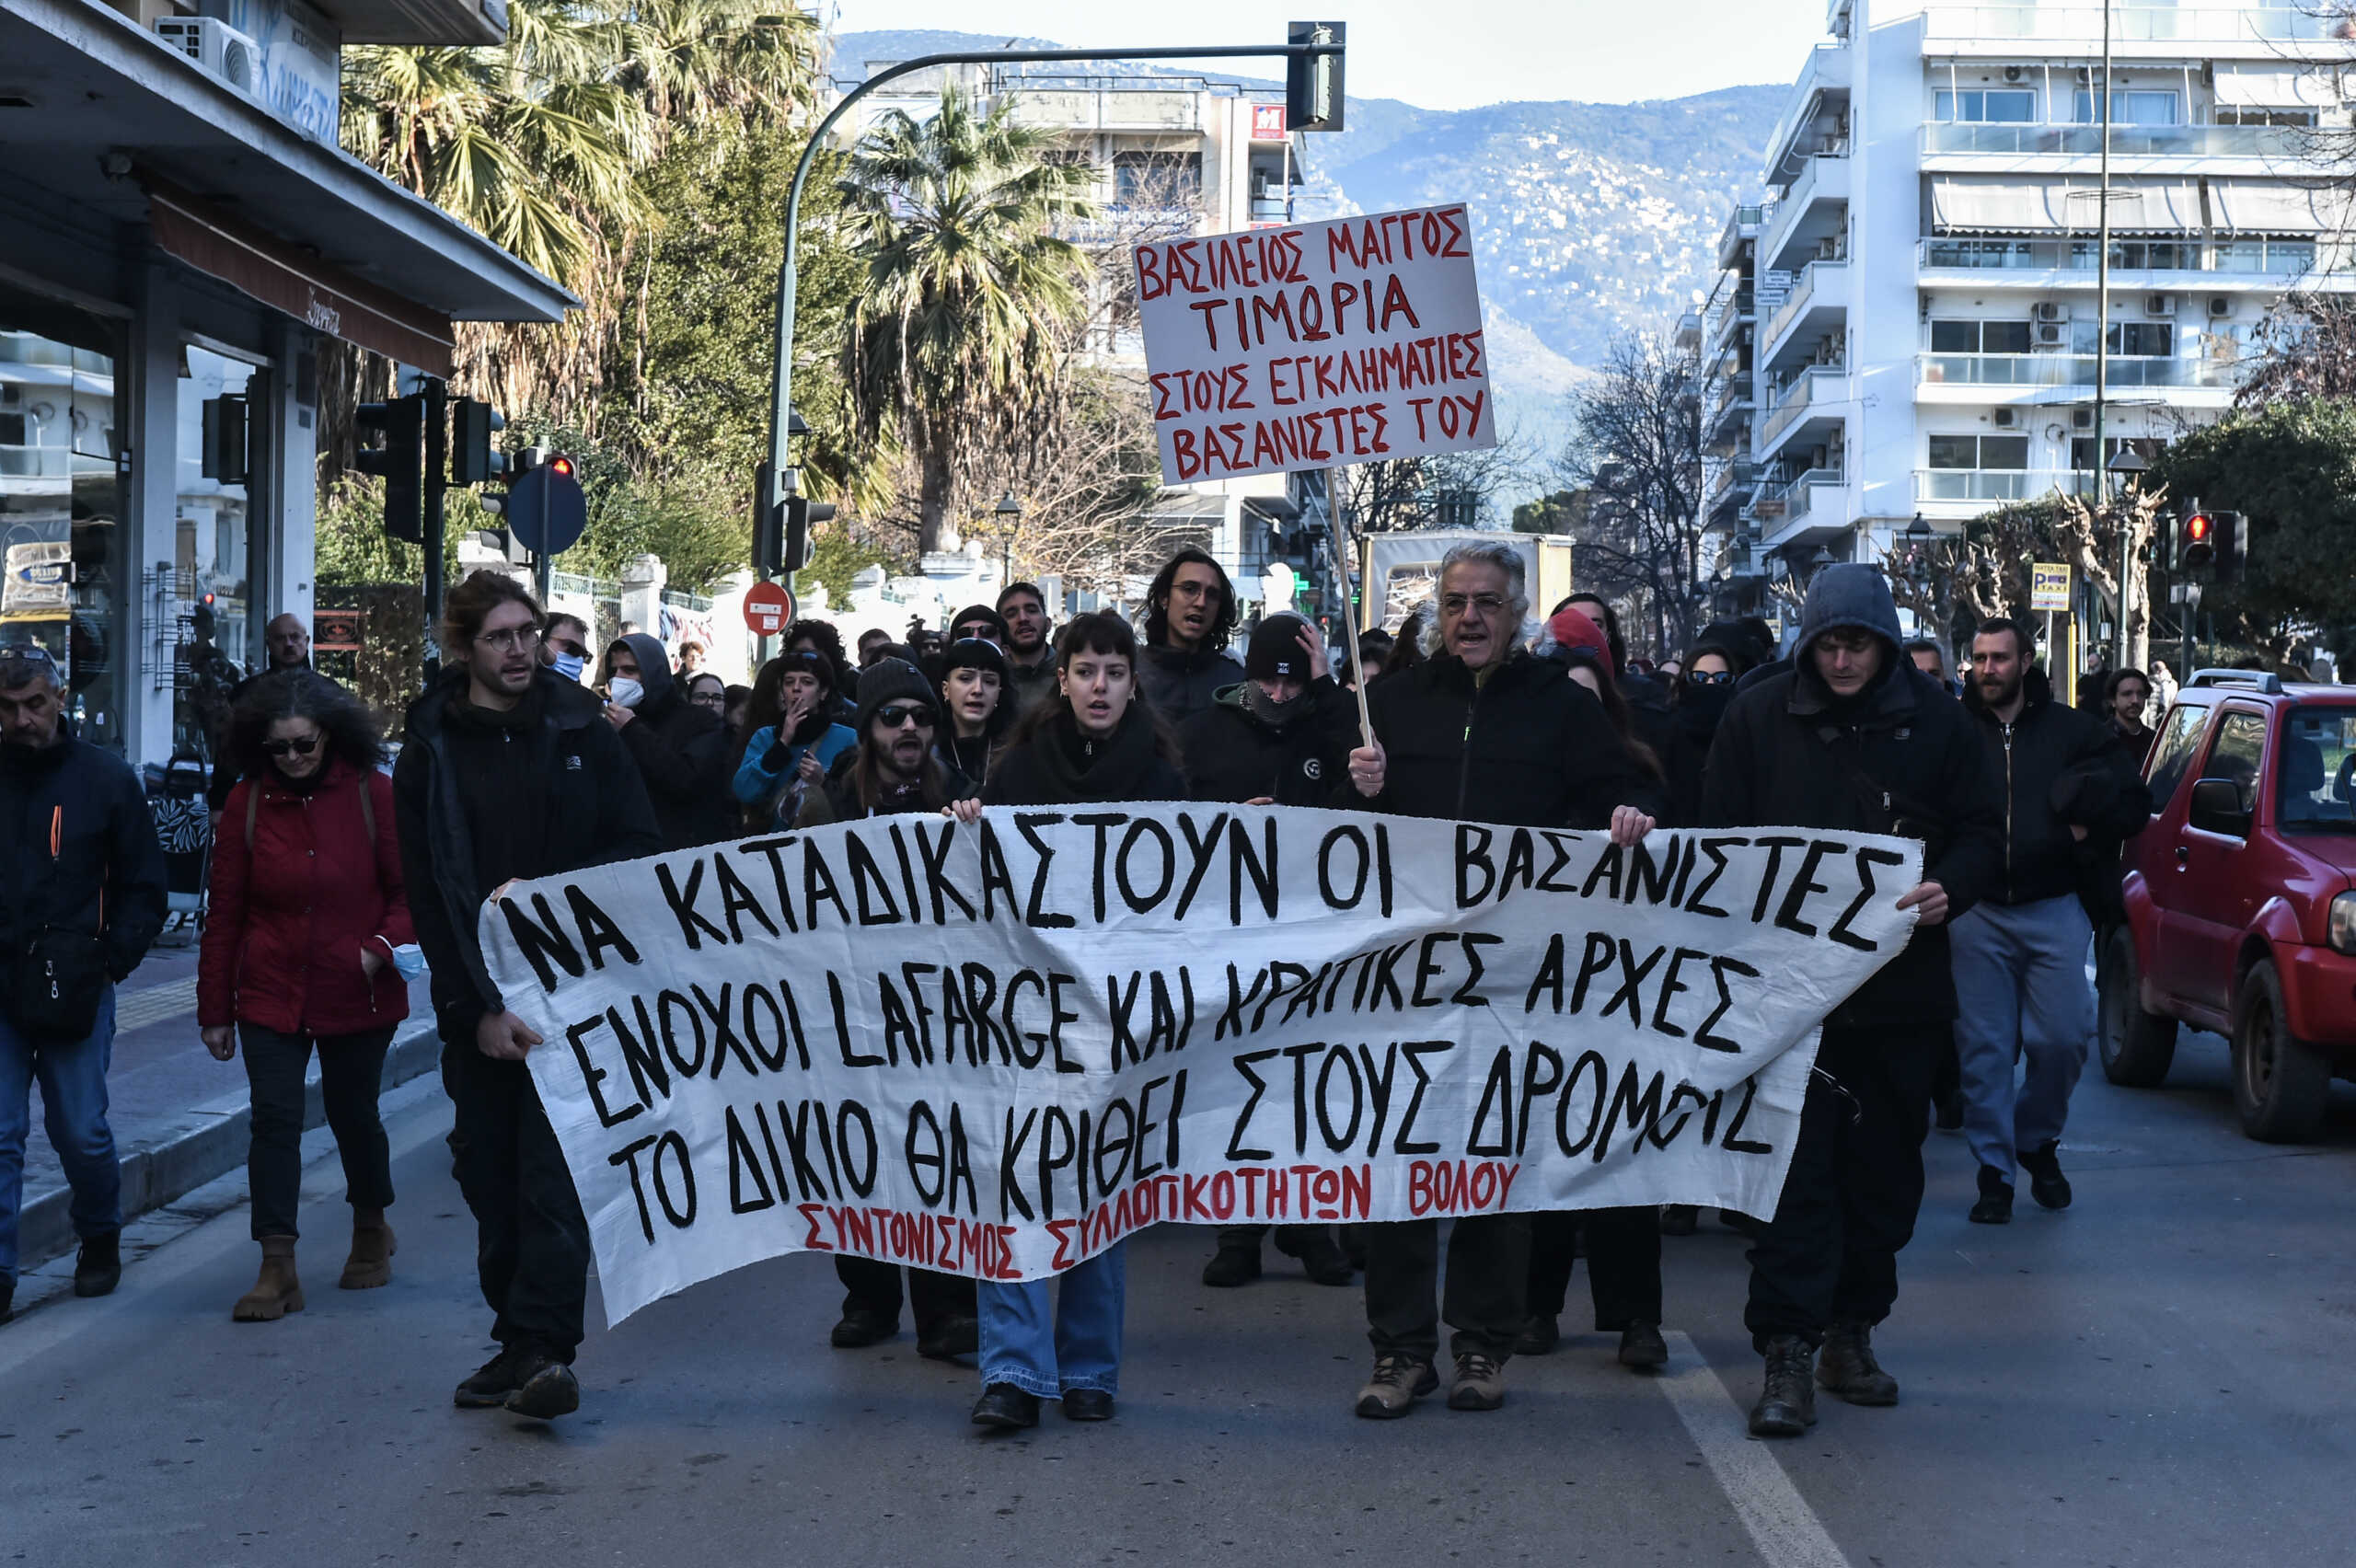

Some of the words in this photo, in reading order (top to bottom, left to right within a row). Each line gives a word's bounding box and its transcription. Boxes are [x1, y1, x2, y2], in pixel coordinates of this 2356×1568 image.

[1136, 231, 1309, 301] ΒΑΣΙΛΕΙΟΣ
[1328, 208, 1470, 273] ΜΑΓΓΟΣ
[1190, 273, 1420, 352] ΤΙΜΩΡΙΑ
[1149, 363, 1254, 421] ΣΤΟΥΣ
[1269, 329, 1484, 405] ΕΓΚΛΗΜΑΤΙΕΣ
[1173, 403, 1391, 480] ΒΑΣΑΝΙΣΤΕΣ
[1407, 390, 1484, 442] ΤΟΥ
[500, 884, 641, 993] ΝΑ
[654, 812, 1278, 951] ΚΑΤΑΔΙΚΑΣΤΟΥΝ
[1318, 824, 1393, 917] ΟΙ
[1456, 824, 1904, 951] ΒΑΣΑΝΙΣΤΕΣ
[566, 979, 810, 1128] ΕΝΟΧΟΙ
[826, 961, 1085, 1074] LAFARGE
[1107, 964, 1195, 1074] ΚΑΙ
[1525, 931, 1762, 1053] ΑΡΧΕΣ
[607, 1129, 698, 1244] ΤΟ
[726, 1099, 877, 1214] ΔΙΚΙΟ
[905, 1100, 979, 1216] ΘΑ
[1000, 1068, 1186, 1222] ΚΡΙΘΕΙ
[1225, 1040, 1455, 1161] ΣΤΟΥΣ
[797, 1203, 1022, 1279] ΣΥΝΤΟΝΙΣΜΟΣ
[1045, 1162, 1371, 1271] ΣΥΛΛΟΓΙΚΟΤΗΤΩΝ
[1410, 1160, 1520, 1217] ΒΟΛΟΥ
